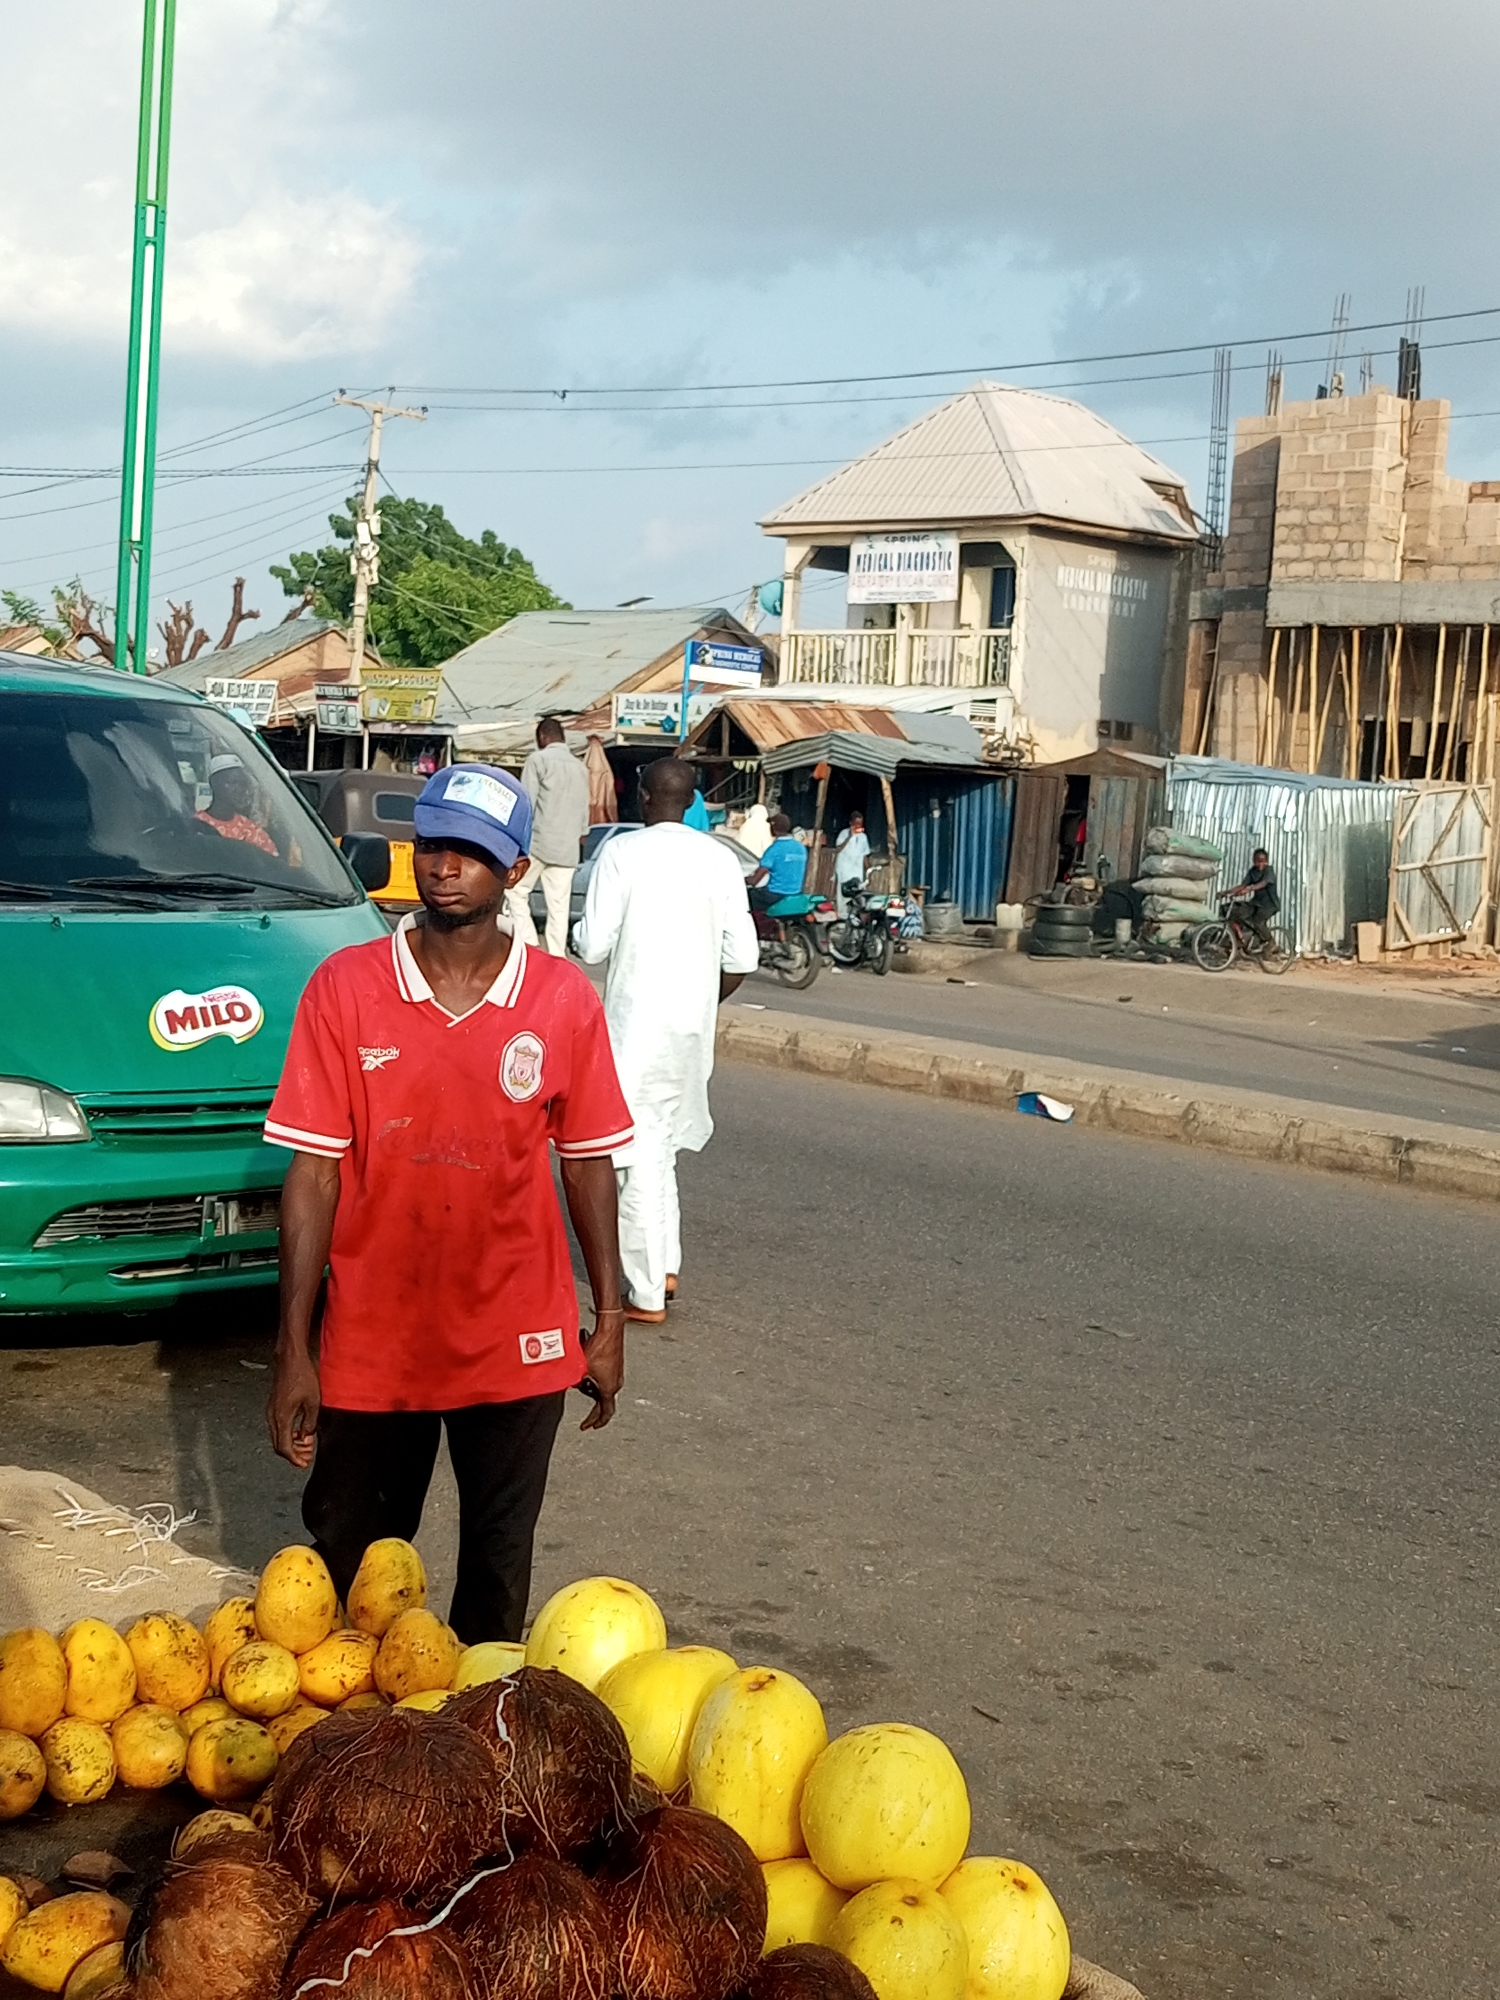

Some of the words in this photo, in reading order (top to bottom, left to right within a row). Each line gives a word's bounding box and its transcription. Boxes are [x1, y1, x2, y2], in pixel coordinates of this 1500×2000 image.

[855, 552, 894, 573] MEDICAL
[896, 550, 953, 572] DIAGNOSTIC
[1057, 565, 1095, 592] MEDICAL
[1096, 571, 1148, 601] DIAGNOSTIC
[164, 1001, 253, 1035] MILO
